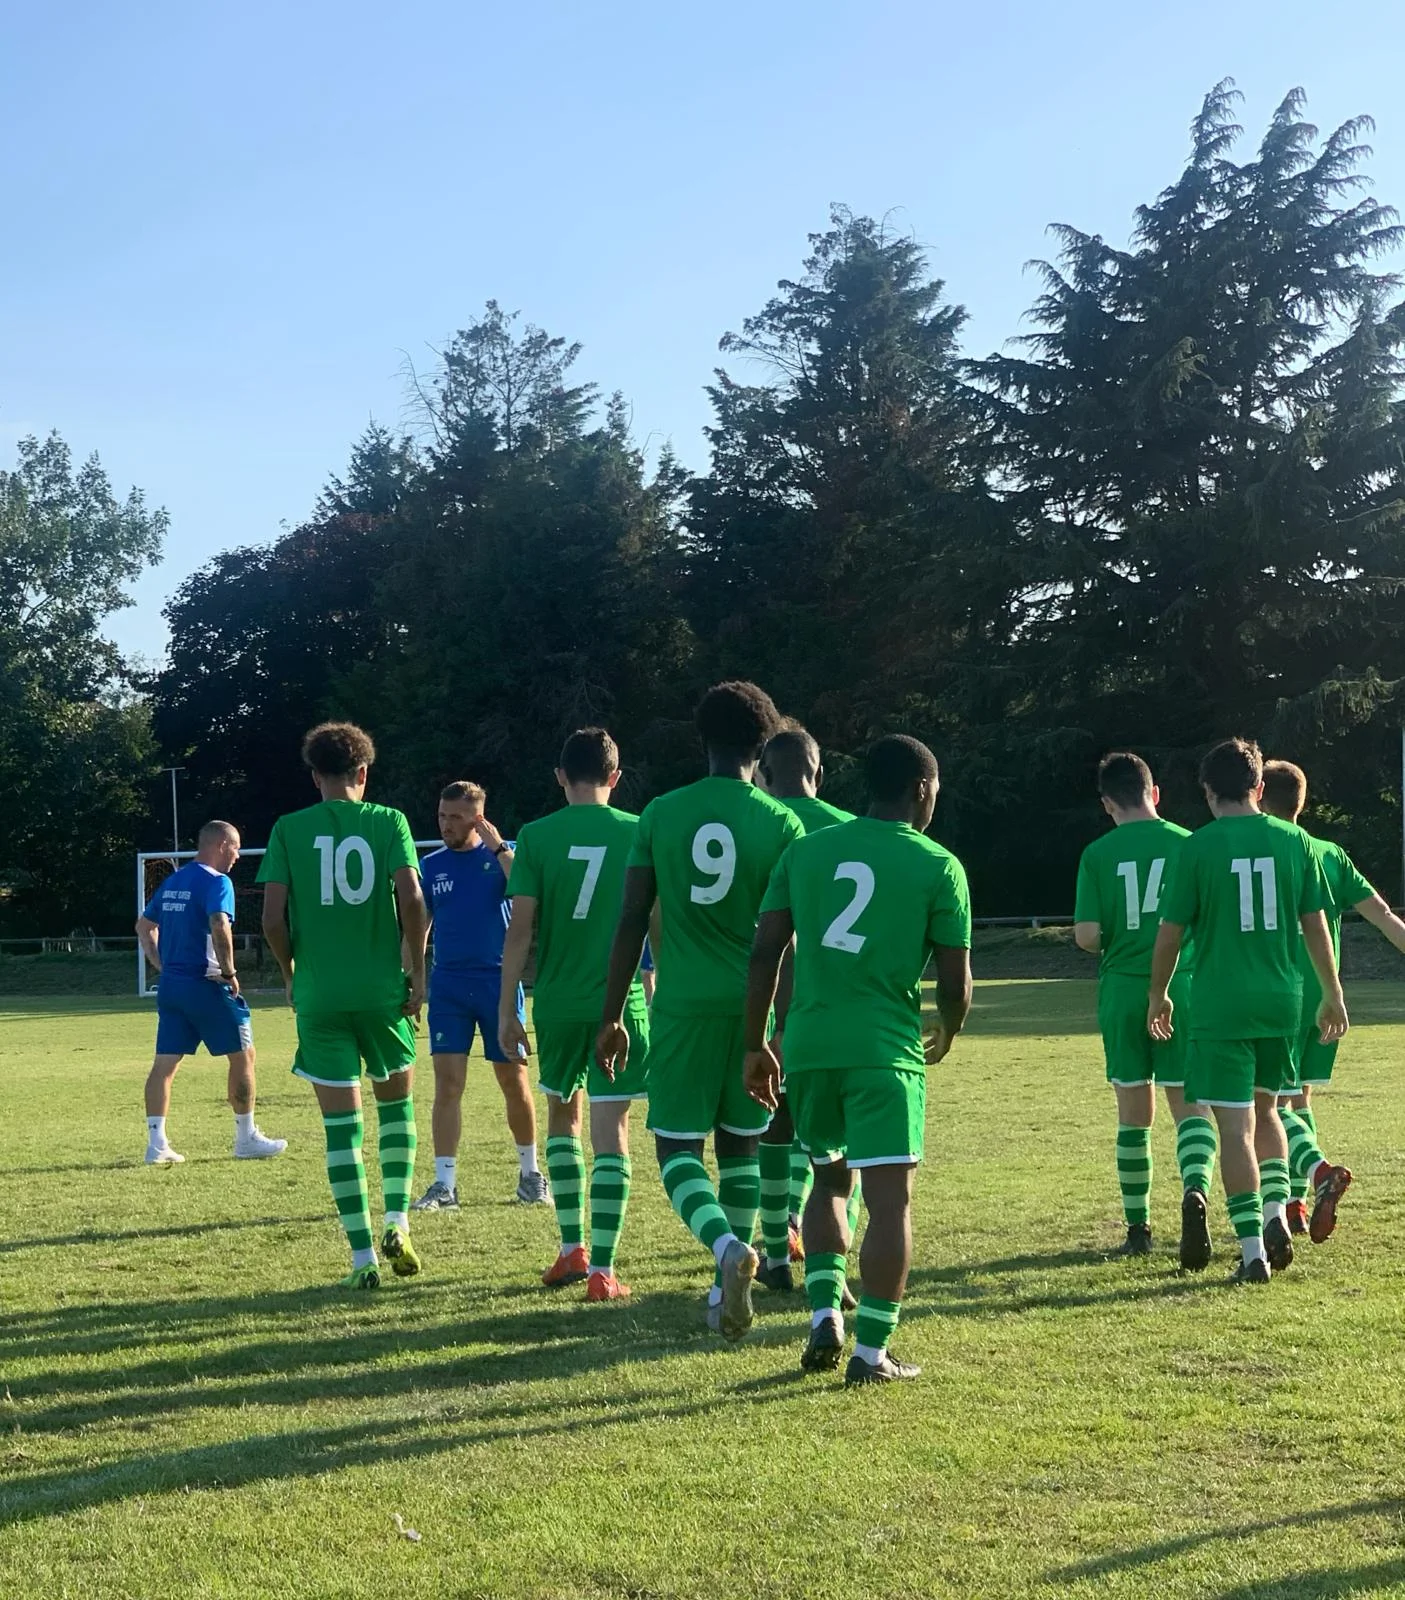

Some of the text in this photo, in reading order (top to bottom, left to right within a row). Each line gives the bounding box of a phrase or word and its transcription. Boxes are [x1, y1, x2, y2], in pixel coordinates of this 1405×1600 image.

[313, 835, 376, 906] 10
[432, 880, 454, 896] HW
[567, 845, 608, 920] 7
[690, 822, 737, 905] 9
[1231, 856, 1278, 932] 11
[821, 861, 875, 954] 2
